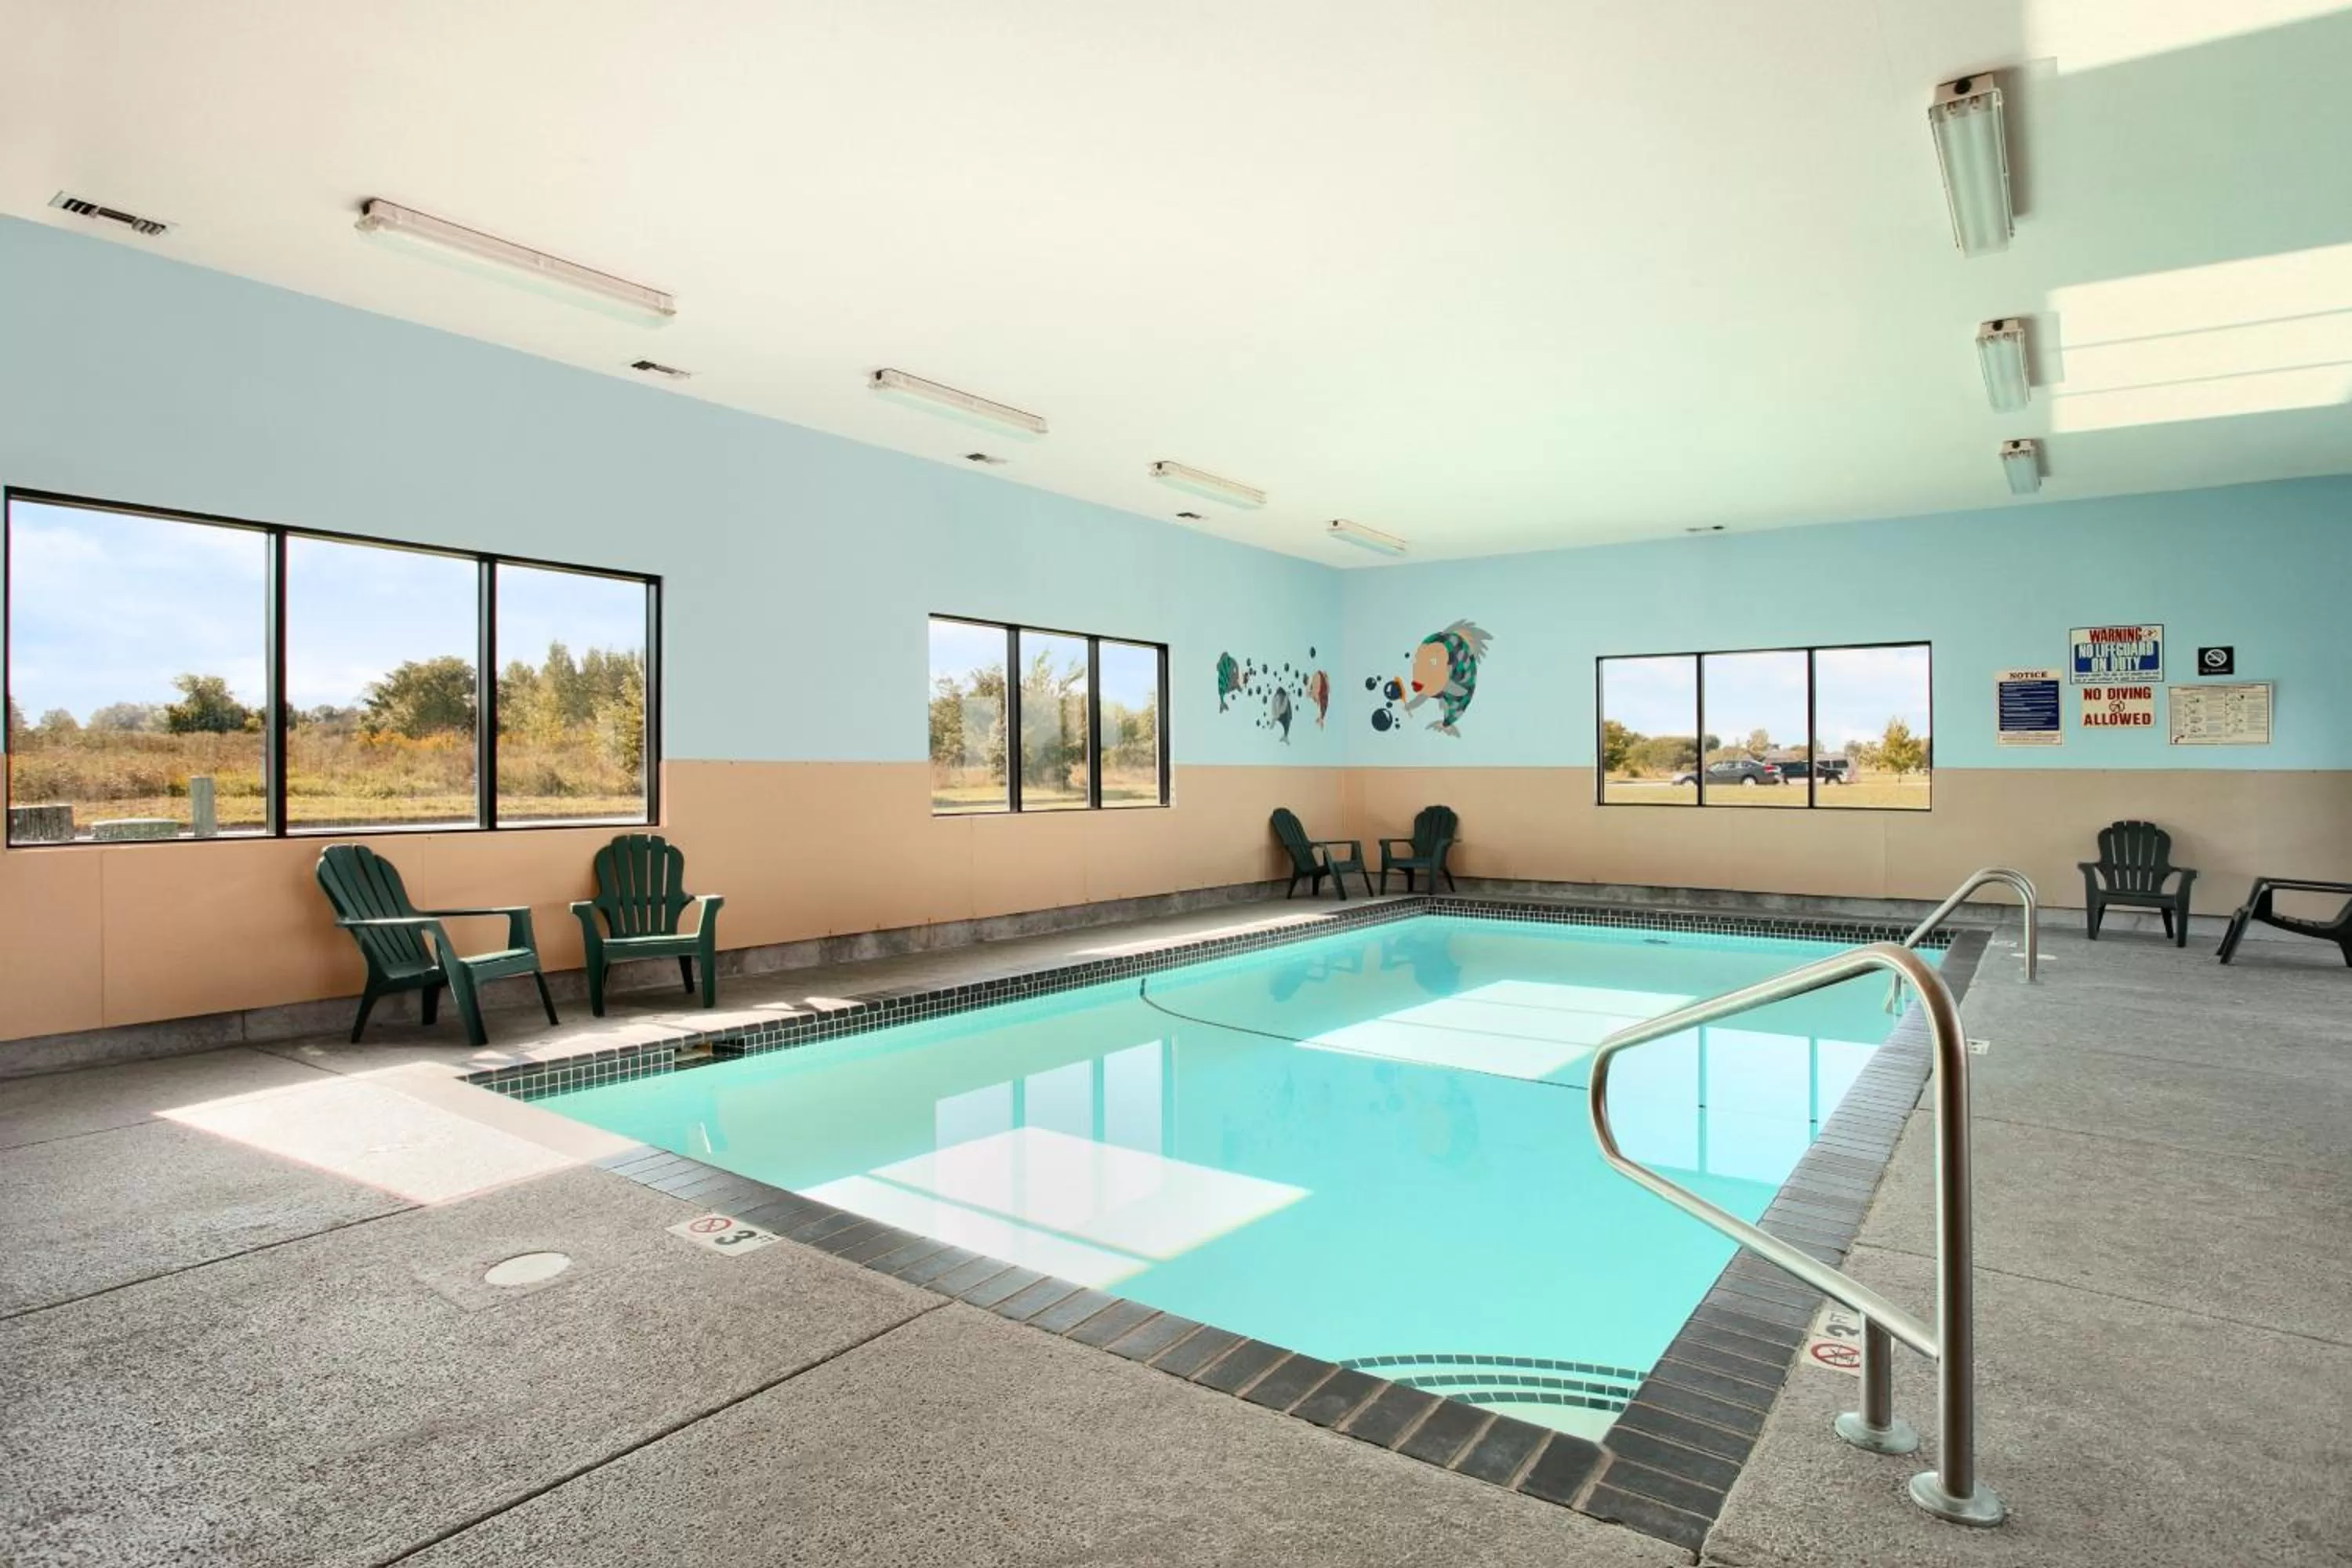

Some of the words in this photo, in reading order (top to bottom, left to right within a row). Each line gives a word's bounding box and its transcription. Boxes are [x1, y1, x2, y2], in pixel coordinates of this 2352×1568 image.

[2089, 627, 2142, 642] WARNING
[2078, 644, 2094, 659] NO
[2096, 641, 2154, 657] LIFEGUARD
[2091, 657, 2107, 671] ON
[2111, 656, 2140, 670] DUTY
[2009, 670, 2048, 680] NOTICE
[2083, 688, 2101, 700] NO
[2107, 686, 2151, 699] DIVING
[2083, 713, 2151, 725] ALLOWED
[714, 1230, 757, 1245] 3
